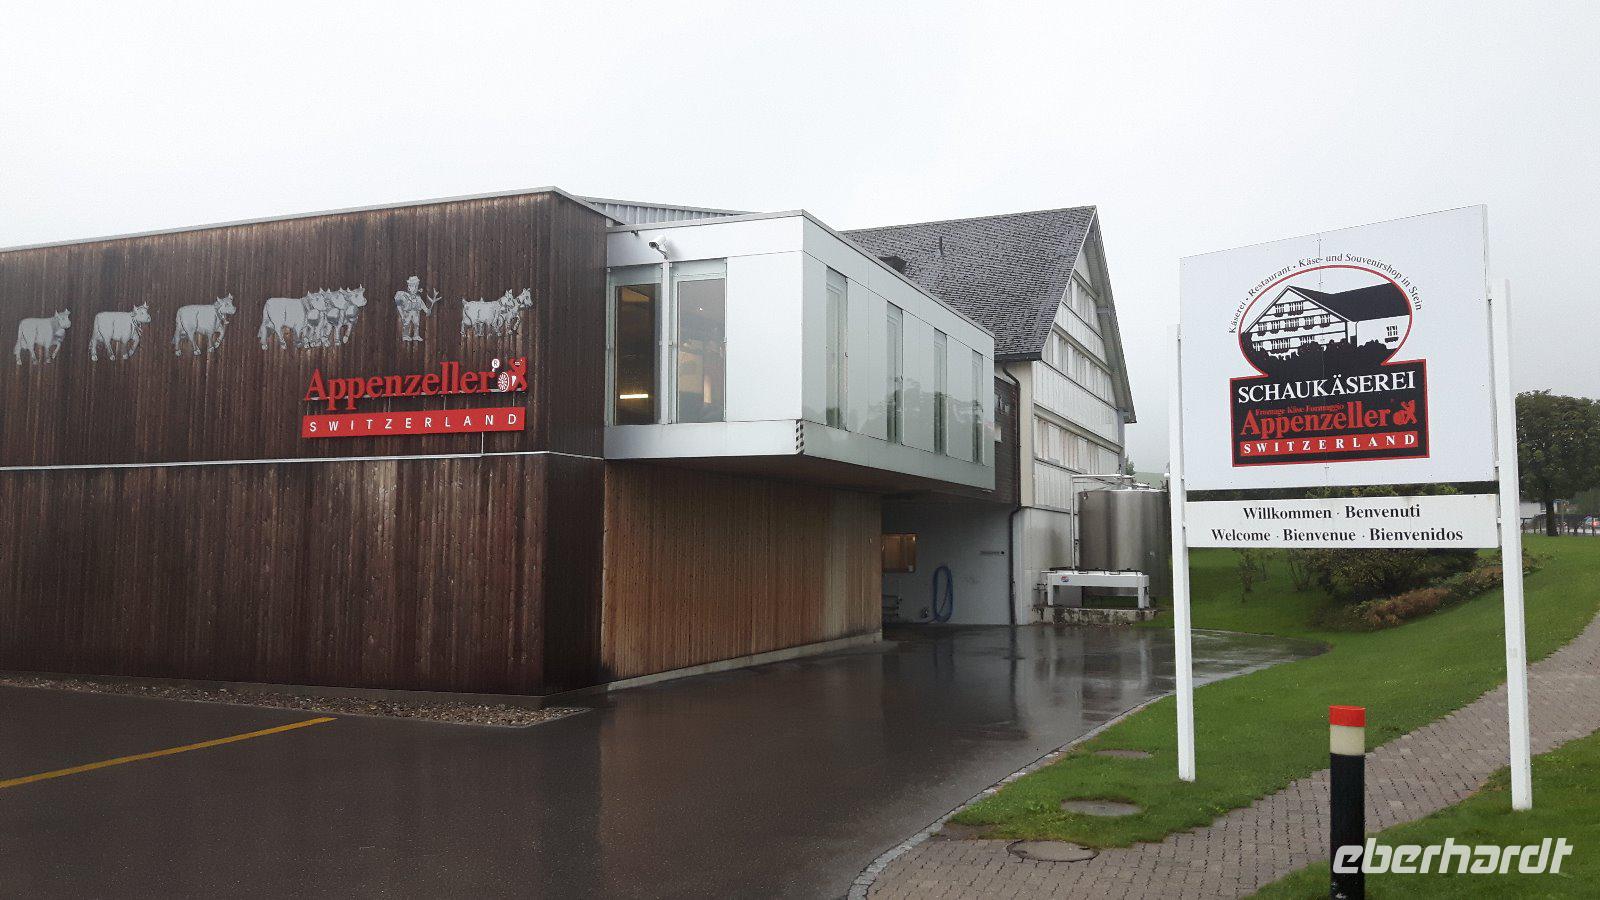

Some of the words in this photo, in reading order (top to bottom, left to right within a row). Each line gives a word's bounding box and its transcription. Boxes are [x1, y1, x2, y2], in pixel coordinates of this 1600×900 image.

[1229, 301, 1247, 333] Käserei
[1248, 265, 1292, 297] Restaurant
[1299, 257, 1323, 268] Käse-
[1325, 253, 1343, 262] und
[1345, 253, 1402, 280] Souvenirshop
[1401, 276, 1411, 288] in
[1408, 285, 1423, 311] Stein
[305, 361, 496, 411] Appenzeller
[1238, 370, 1416, 404] SCHAUKÄSEREI
[309, 413, 517, 432] SWITZERLAND
[1240, 401, 1392, 439] Appenzeller
[1244, 434, 1415, 454] SWITZERLAND
[1243, 507, 1332, 520] Willkommen
[1345, 504, 1420, 518] Benvenuti
[1211, 528, 1271, 541] Welcome
[1283, 528, 1356, 541] Bienvenue
[1369, 527, 1463, 541] Bienvenidos
